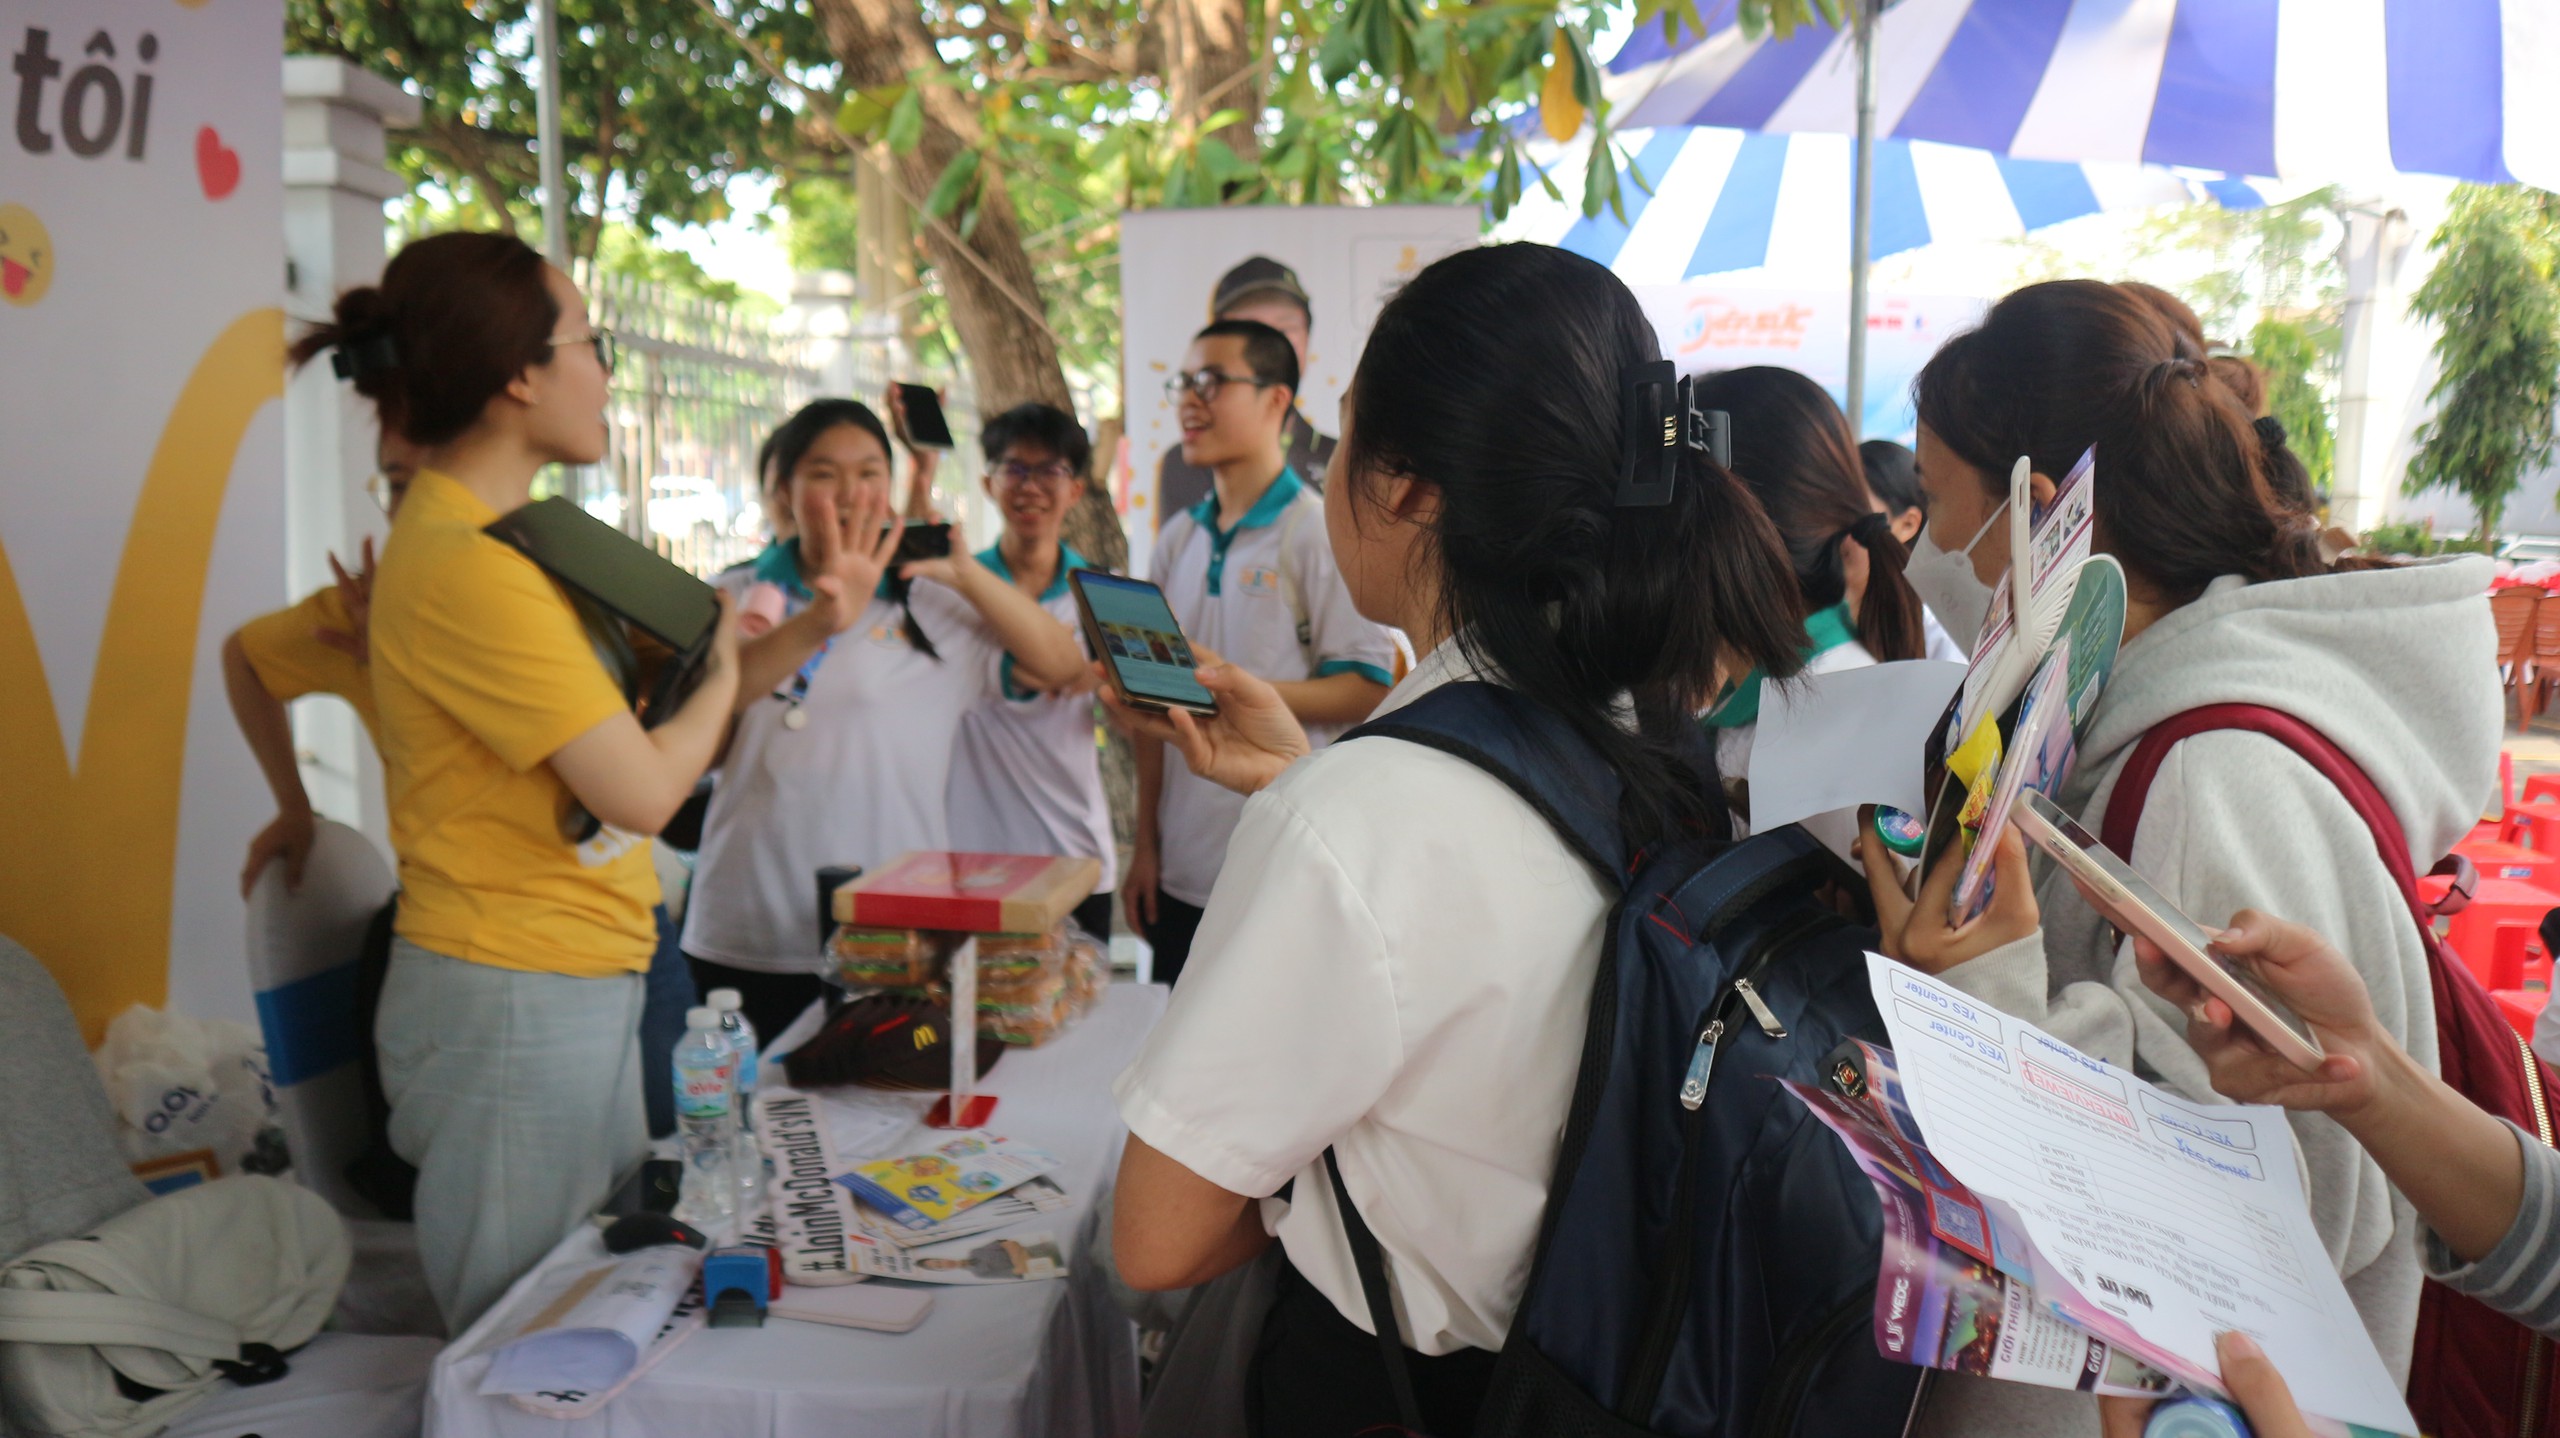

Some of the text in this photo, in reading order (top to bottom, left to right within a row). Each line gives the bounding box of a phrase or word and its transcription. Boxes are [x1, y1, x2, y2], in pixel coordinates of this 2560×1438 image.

[13, 27, 158, 161] tôi
[1905, 980, 1977, 1023] YES Center
[1929, 1020, 2005, 1063] YES Center
[2038, 1036, 2105, 1075] YES Center
[2022, 1068, 2131, 1128] INTERVIEWED
[1892, 1278, 1909, 1320] WEDC
